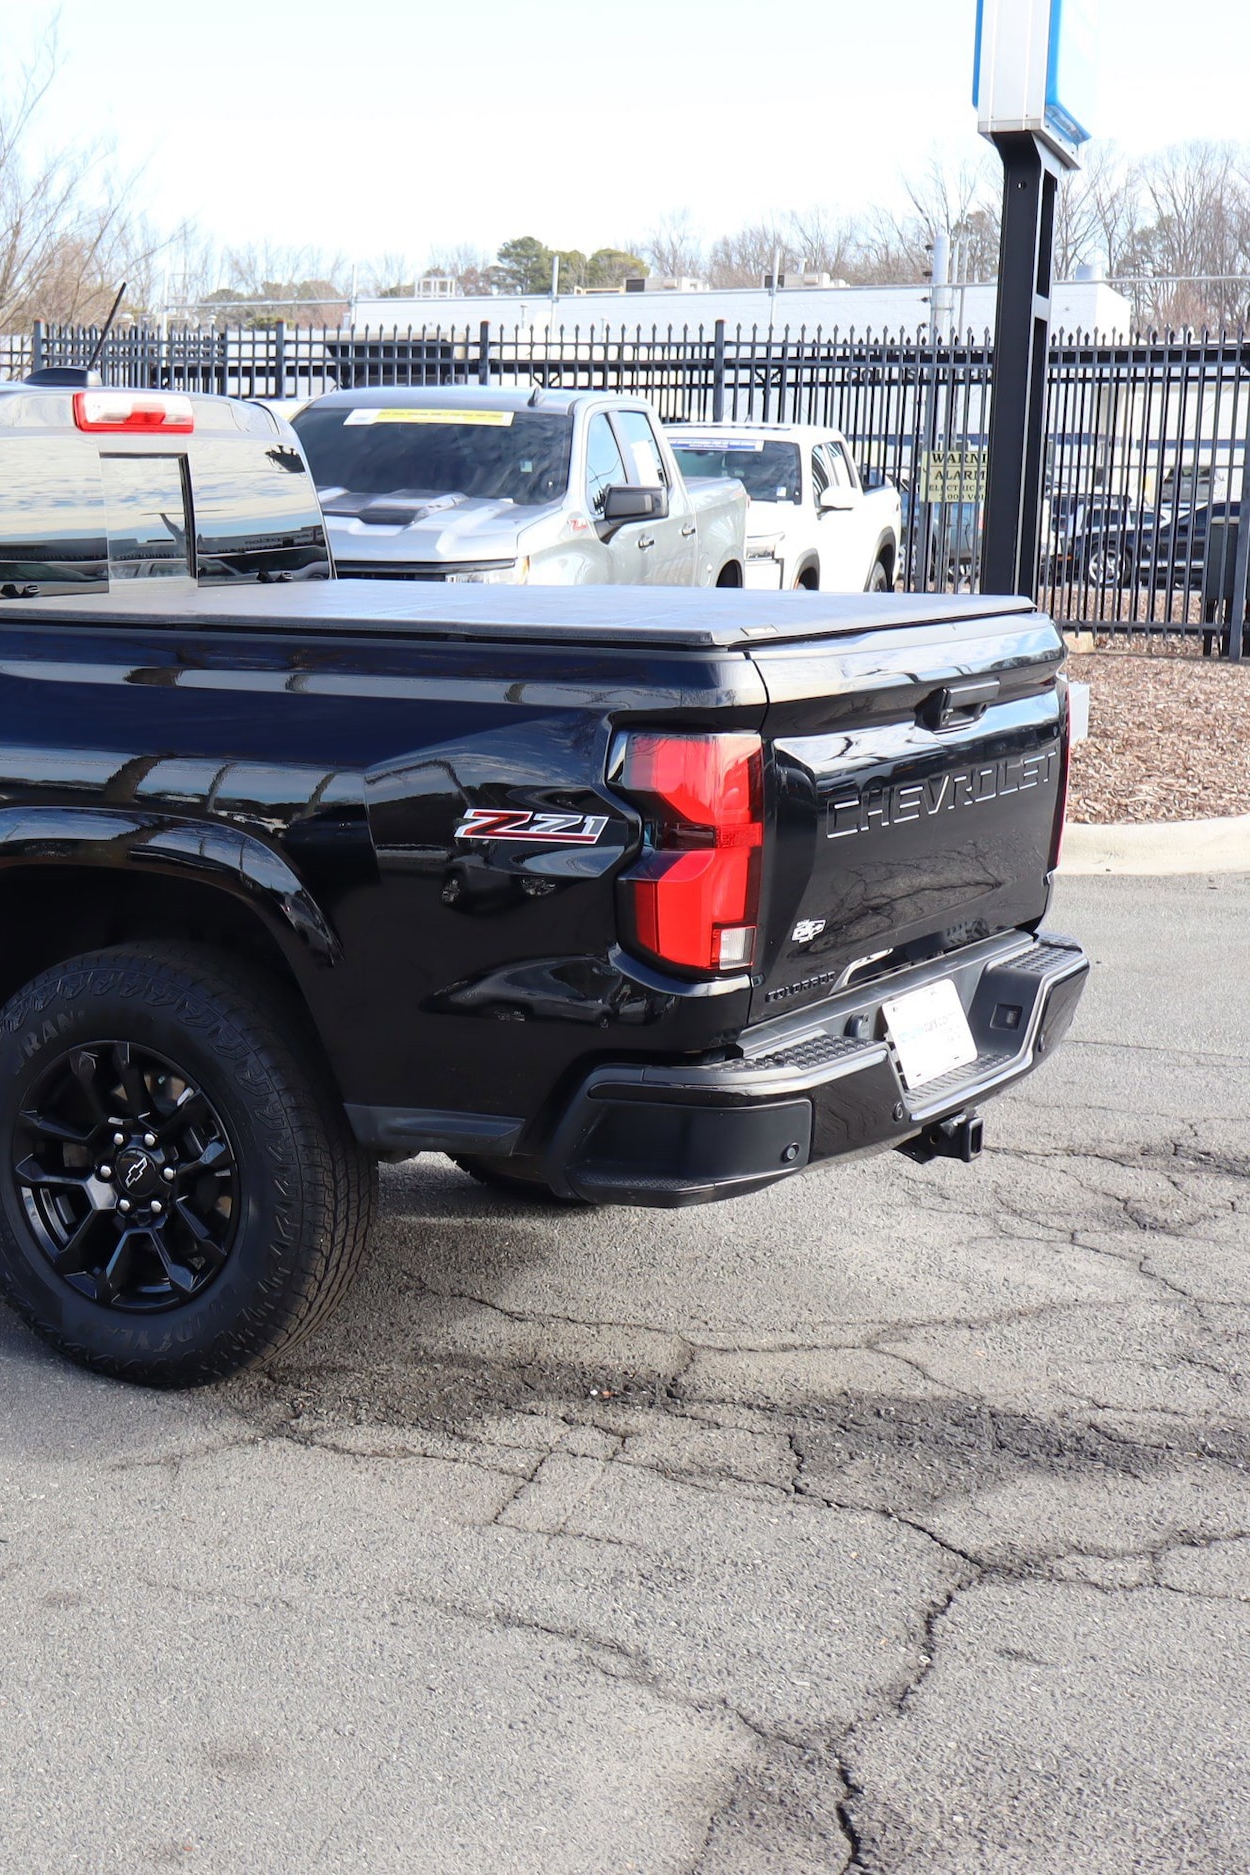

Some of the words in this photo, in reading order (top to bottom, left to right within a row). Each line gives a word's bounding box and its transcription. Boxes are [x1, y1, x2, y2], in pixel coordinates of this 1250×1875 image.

[928, 484, 975, 492] ELCTIC
[826, 750, 1057, 840] CHEVROLET
[454, 808, 610, 845] Z71
